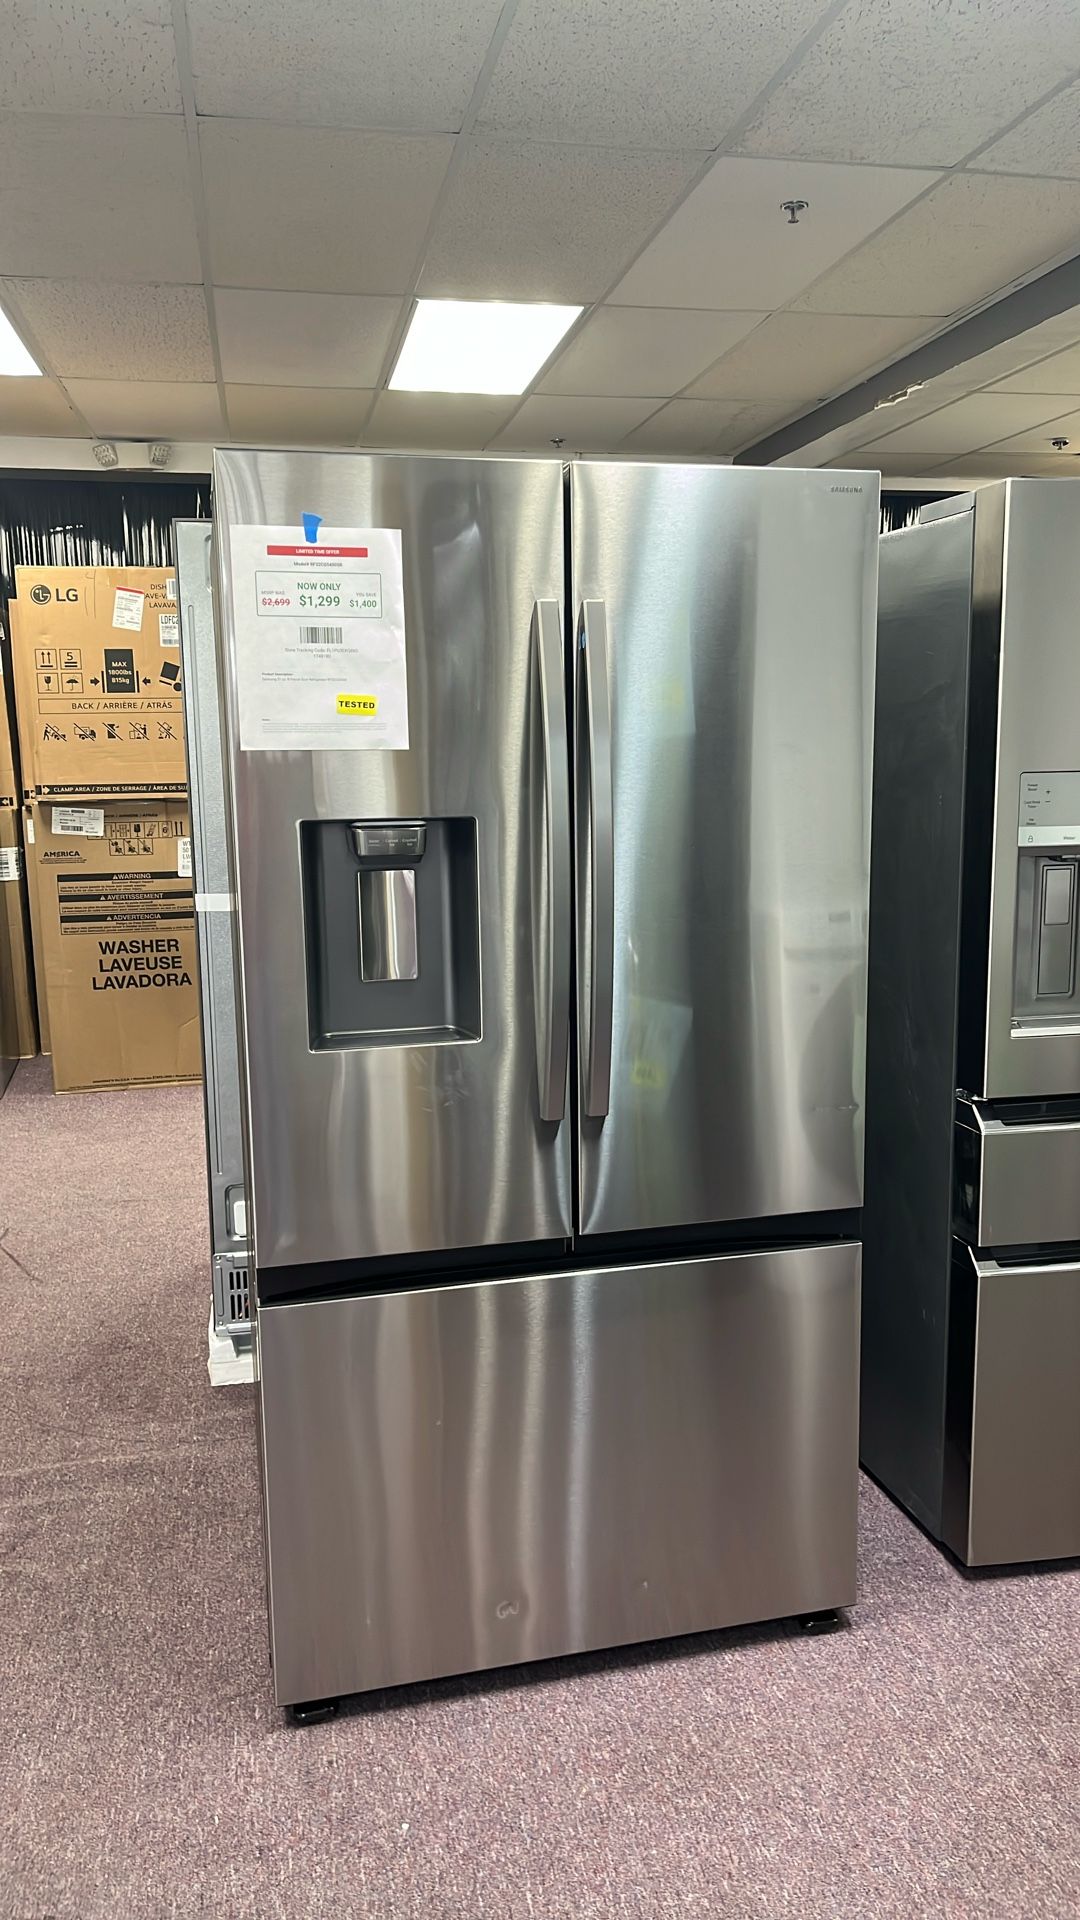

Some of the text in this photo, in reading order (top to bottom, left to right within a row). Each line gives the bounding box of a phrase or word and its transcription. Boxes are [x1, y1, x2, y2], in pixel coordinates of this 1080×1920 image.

[297, 582, 341, 591] NOW ONLY
[56, 588, 78, 602] LG
[262, 598, 290, 607] $2,699
[299, 594, 340, 608] $1,299
[349, 599, 377, 609] $1,400
[111, 677, 130, 685] 815kg
[72, 702, 94, 710] BACK
[338, 700, 375, 709] TESTED
[43, 850, 80, 858] AMERICA
[113, 913, 162, 921] ADVERTENCIA
[98, 939, 179, 955] WASHER
[99, 956, 182, 972] LAVEUSE
[92, 973, 192, 990] LAVADORA
